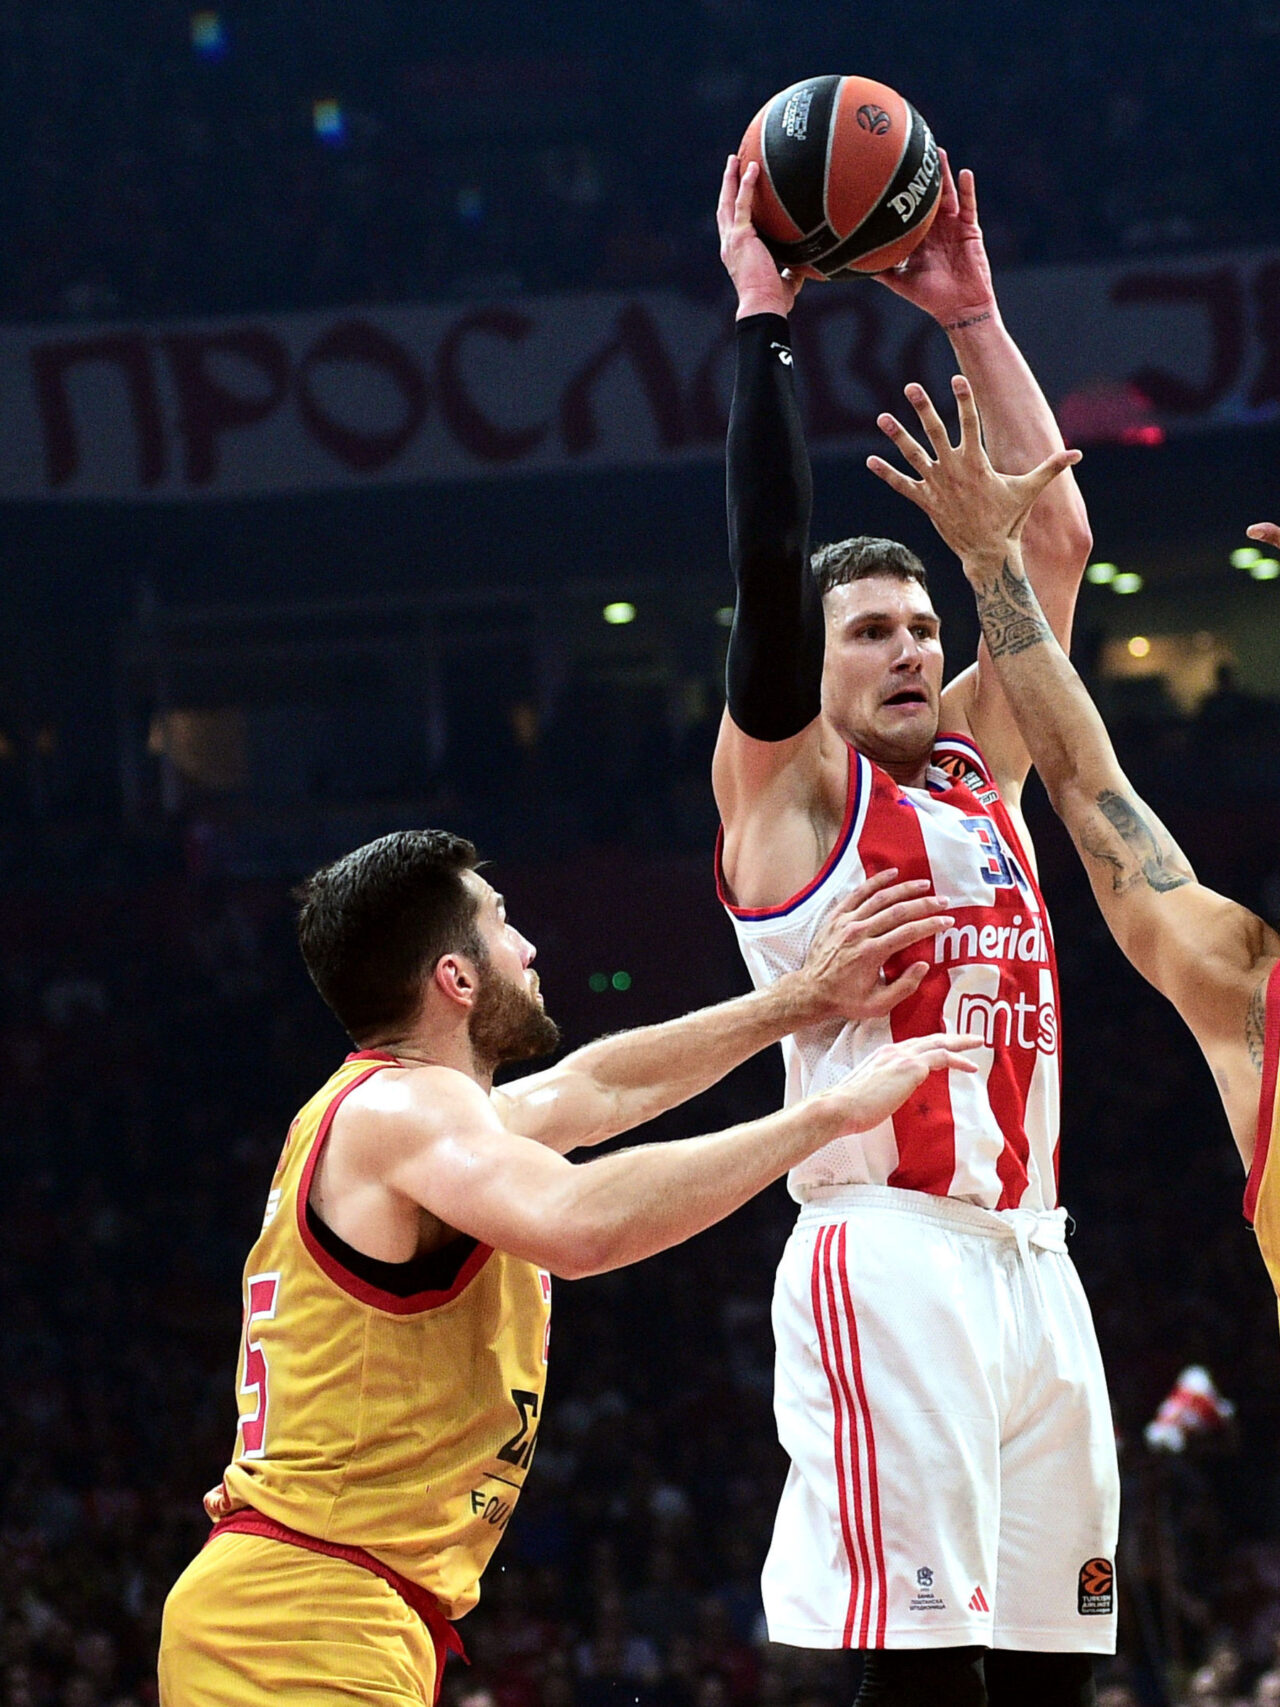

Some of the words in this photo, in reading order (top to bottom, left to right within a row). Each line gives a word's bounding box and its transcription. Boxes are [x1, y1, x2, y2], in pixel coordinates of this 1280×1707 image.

[959, 816, 1029, 893] 3
[934, 914, 1049, 964] meridi
[958, 991, 1057, 1055] mts
